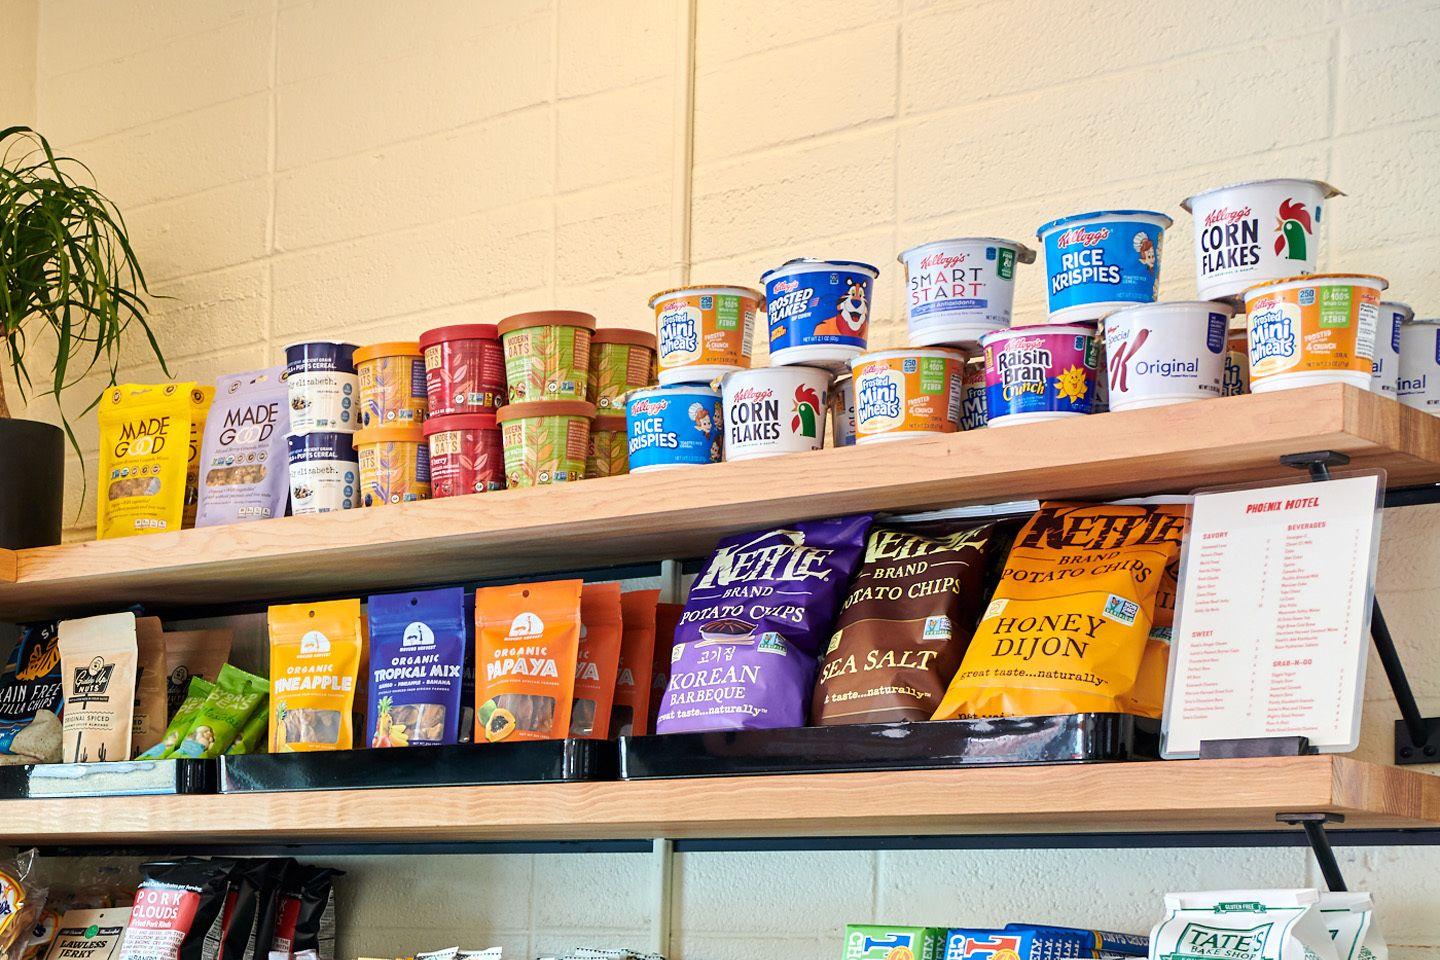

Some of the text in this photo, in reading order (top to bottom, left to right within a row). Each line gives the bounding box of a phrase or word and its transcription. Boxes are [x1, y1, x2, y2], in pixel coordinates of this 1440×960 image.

[1204, 206, 1252, 226] Kellogg's
[1057, 227, 1110, 248] Kellogg's
[1201, 218, 1259, 253] CORN
[920, 252, 967, 269] Kellogg's
[1061, 249, 1103, 269] RICE
[1202, 245, 1261, 275] FLAKES
[911, 268, 983, 290] SMART
[1051, 266, 1121, 294] KRISPIES
[769, 288, 813, 315] FROSTED
[911, 283, 984, 305] START
[1299, 289, 1315, 298] 250
[771, 300, 808, 325] FLAKES
[507, 334, 529, 345] MODERN
[1250, 317, 1293, 346] Mini
[508, 343, 530, 358] OATS
[1251, 333, 1295, 365] Wheats
[998, 350, 1052, 373] Raisin
[1110, 328, 1149, 393] K
[1135, 358, 1199, 377] Original
[862, 376, 889, 388] Frosted
[1001, 365, 1046, 386] Bran
[733, 388, 775, 403] Kellogg's
[859, 384, 897, 408] Mini
[1002, 380, 1047, 401] Crunch
[224, 403, 279, 428] MADE
[631, 399, 669, 417] Kellogg's
[730, 401, 780, 425] CORN
[859, 398, 899, 424] Wheats
[119, 416, 170, 440] MADE
[219, 424, 274, 446] GOOD
[634, 418, 663, 434] RICE
[732, 423, 782, 446] FLAKES
[114, 436, 165, 458] GOOD
[434, 433, 458, 443] MODERN
[435, 441, 458, 454] OATS
[629, 432, 678, 455] KRISPIES
[1246, 497, 1320, 514] PHOENIX MOTEL
[1014, 504, 1192, 551] KETTLE
[1203, 532, 1228, 540] SAVORY
[1287, 521, 1326, 531] BEVERAGES
[691, 531, 835, 591] KETTLE
[1057, 551, 1121, 566] BRAND
[873, 561, 928, 580] BRAND
[1000, 559, 1153, 584] POTATO CHIPS
[721, 586, 774, 599] BRAND
[907, 578, 962, 599] CHIPS
[680, 604, 805, 625] POTATO CHIPS
[993, 613, 1106, 639] HONEY
[494, 647, 548, 658] ORGANIC
[991, 636, 1089, 661] DIJON
[287, 664, 334, 675] ORGANIC
[392, 654, 439, 666] ORGANIC
[487, 659, 558, 680] PAPAYA
[820, 650, 938, 685] SEA SALT
[1273, 659, 1312, 667] GRAB-N-GO
[374, 665, 460, 683] TROPICAL MIX
[669, 666, 761, 691] KOREAN
[960, 669, 991, 680] great
[31, 683, 63, 699] FREE
[669, 686, 747, 705] BARBEQUE
[27, 697, 55, 712] CHIPS
[136, 890, 184, 904] PORK
[132, 905, 179, 920] CLOUDS
[59, 940, 108, 948] LAWLESS
[1189, 929, 1264, 952] TATE'S
[58, 950, 95, 959] JERKY
[1191, 946, 1256, 960] BAKE SHOP
